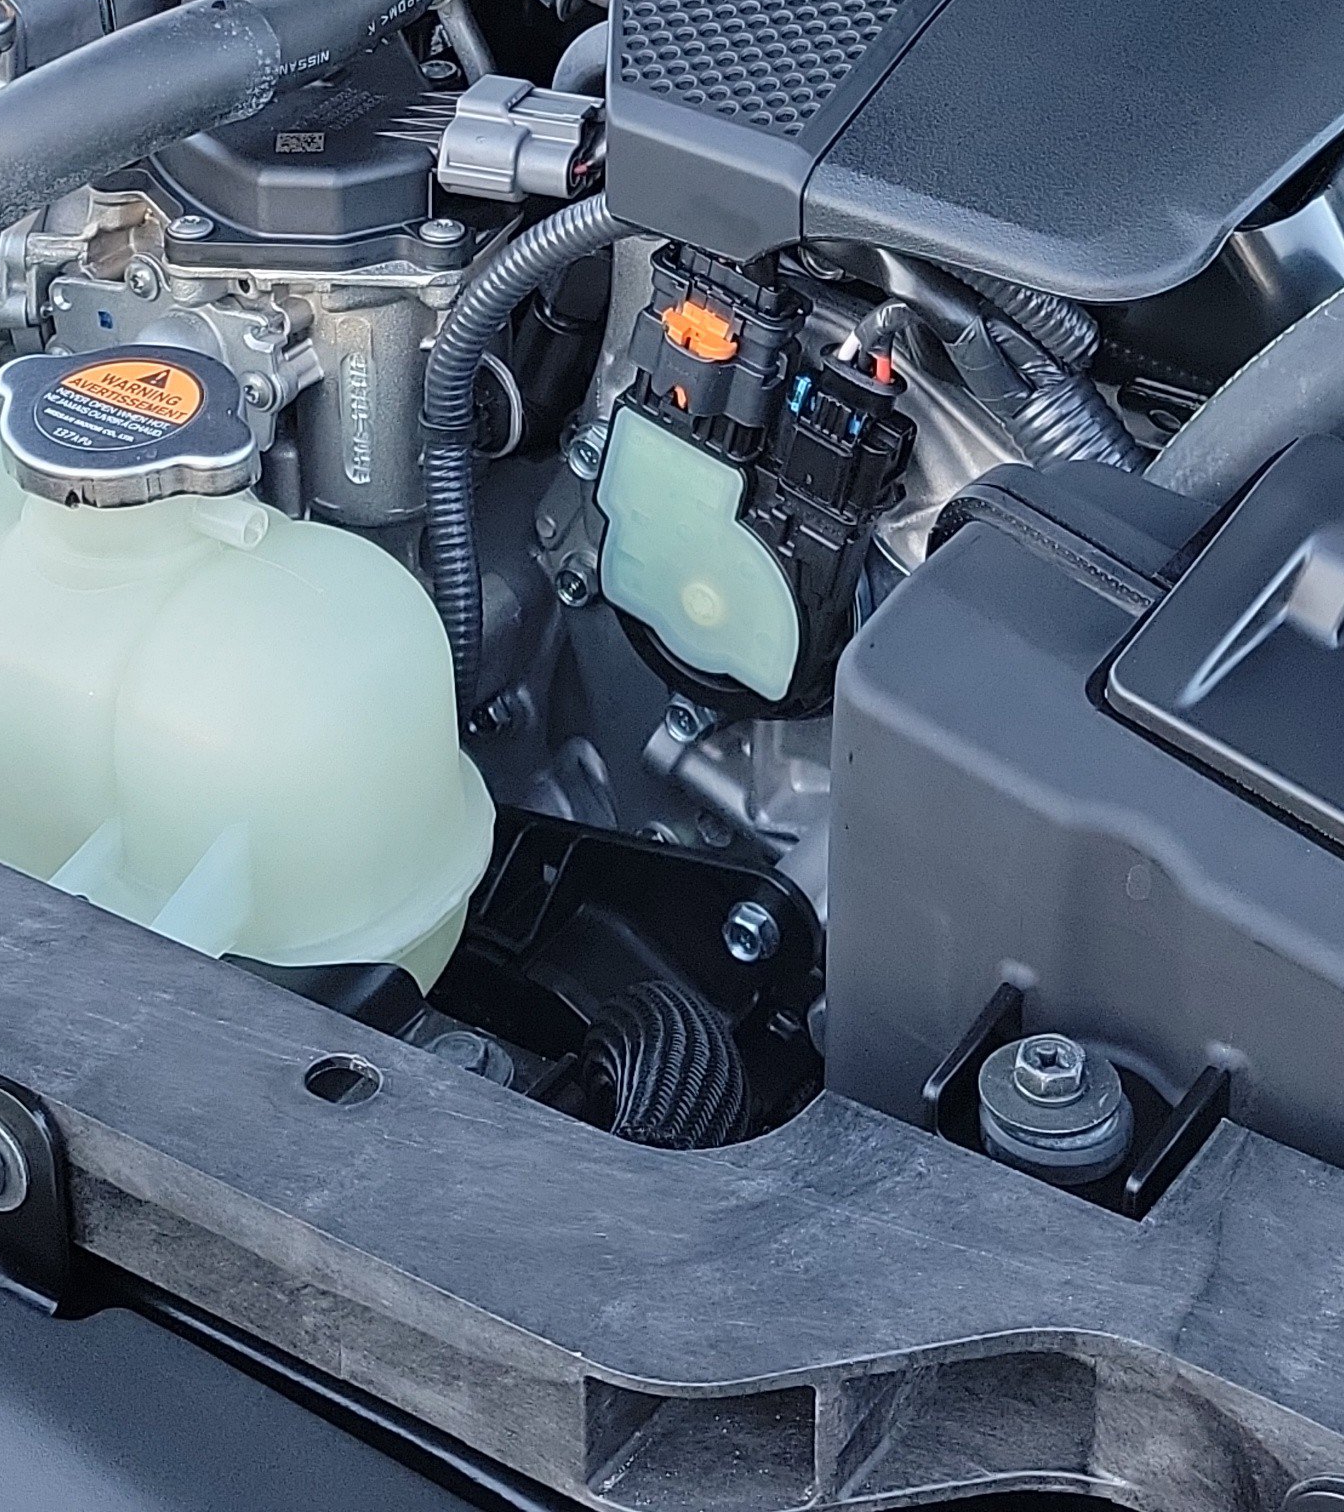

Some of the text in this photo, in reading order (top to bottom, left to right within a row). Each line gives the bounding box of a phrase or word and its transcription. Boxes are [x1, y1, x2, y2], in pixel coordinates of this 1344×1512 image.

[278, 50, 330, 76] NISSAN
[68, 377, 188, 420] AVERTISSEMENT
[101, 373, 182, 406] WARNING
